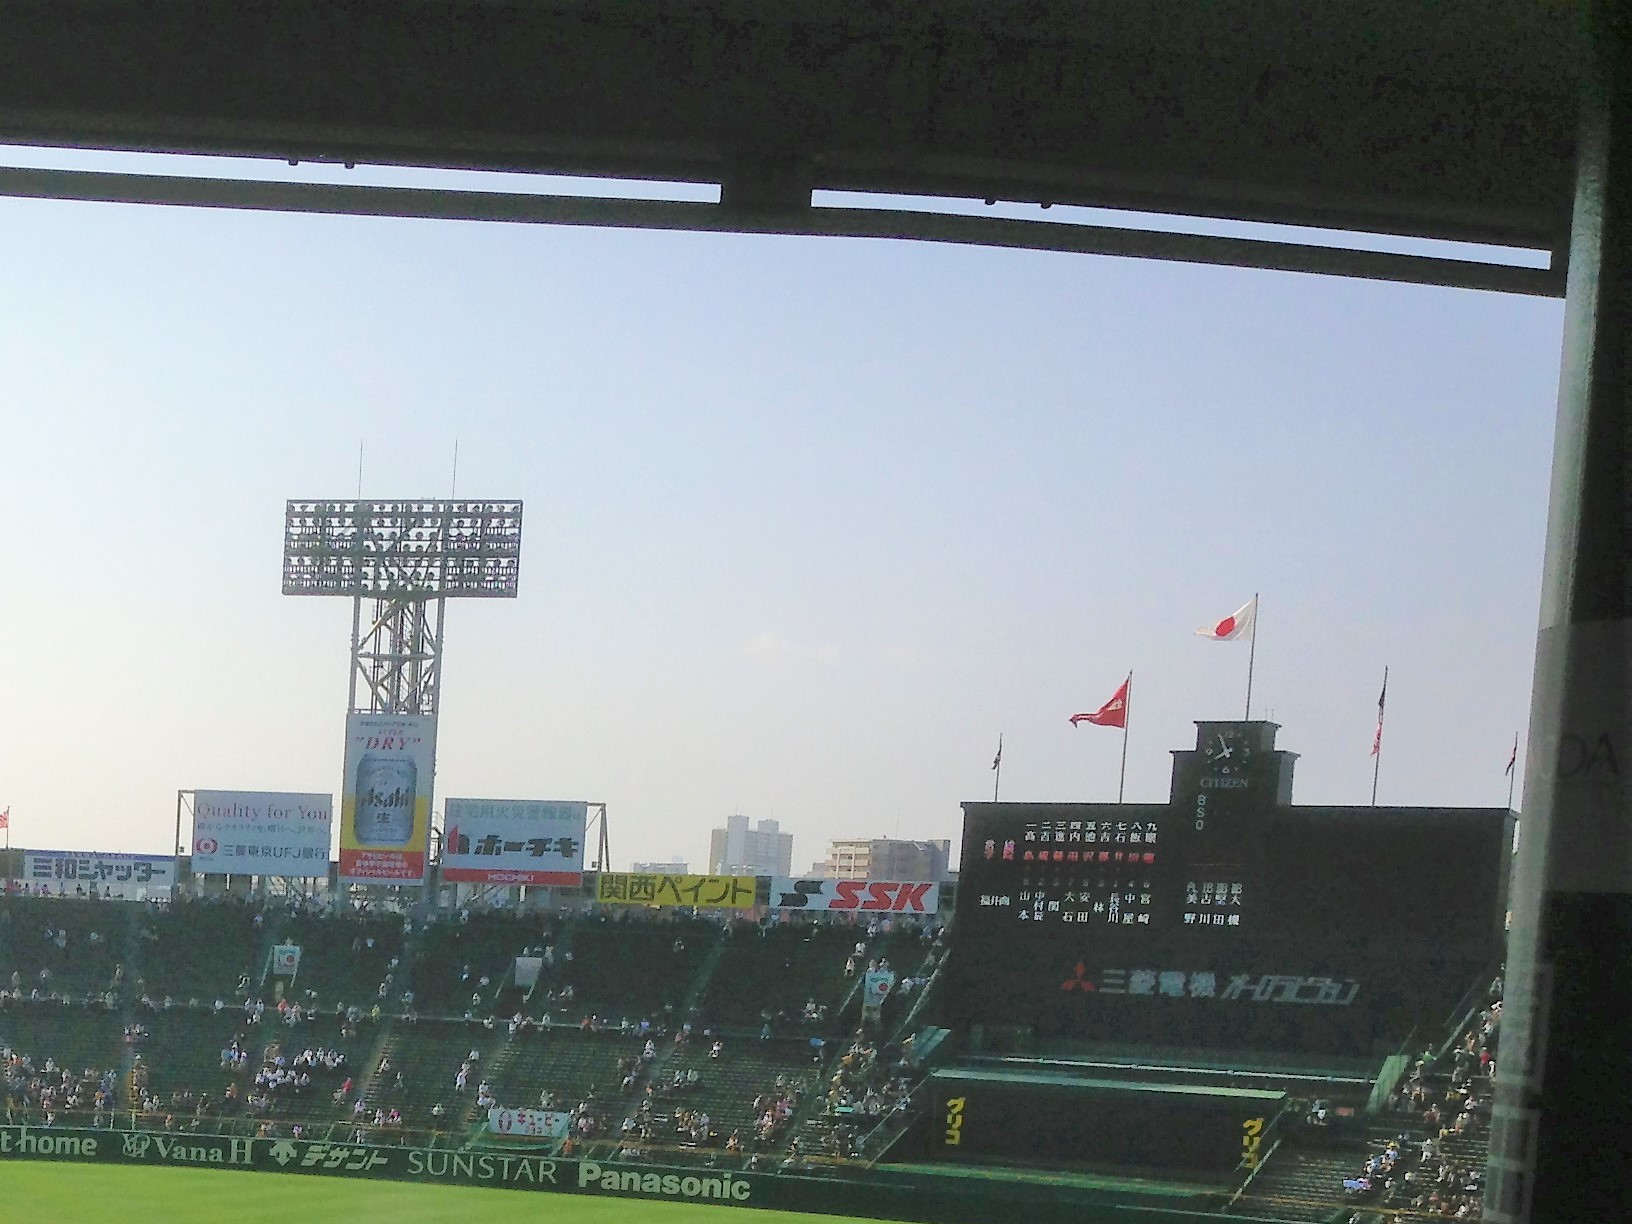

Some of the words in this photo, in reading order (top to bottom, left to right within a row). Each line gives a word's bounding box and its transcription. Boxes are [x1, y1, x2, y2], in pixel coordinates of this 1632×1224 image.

[361, 787, 410, 809] Asahi
[1200, 778, 1249, 789] CITIZEN
[198, 802, 261, 822] Quality
[268, 803, 291, 819] for
[299, 805, 328, 820] You
[475, 834, 579, 858] ホーチキ
[33, 857, 166, 883] 三和シャッター
[600, 874, 752, 905] 関西ペイント
[829, 881, 933, 911] SSK
[1099, 969, 1216, 998] 三菱電機
[945, 1097, 966, 1145] グリコ
[16, 1127, 99, 1157] home
[1242, 1118, 1264, 1170] グリコ
[300, 1143, 388, 1171] デサント
[407, 1150, 558, 1185] SUNSTAR
[577, 1162, 752, 1201] Panasonic
